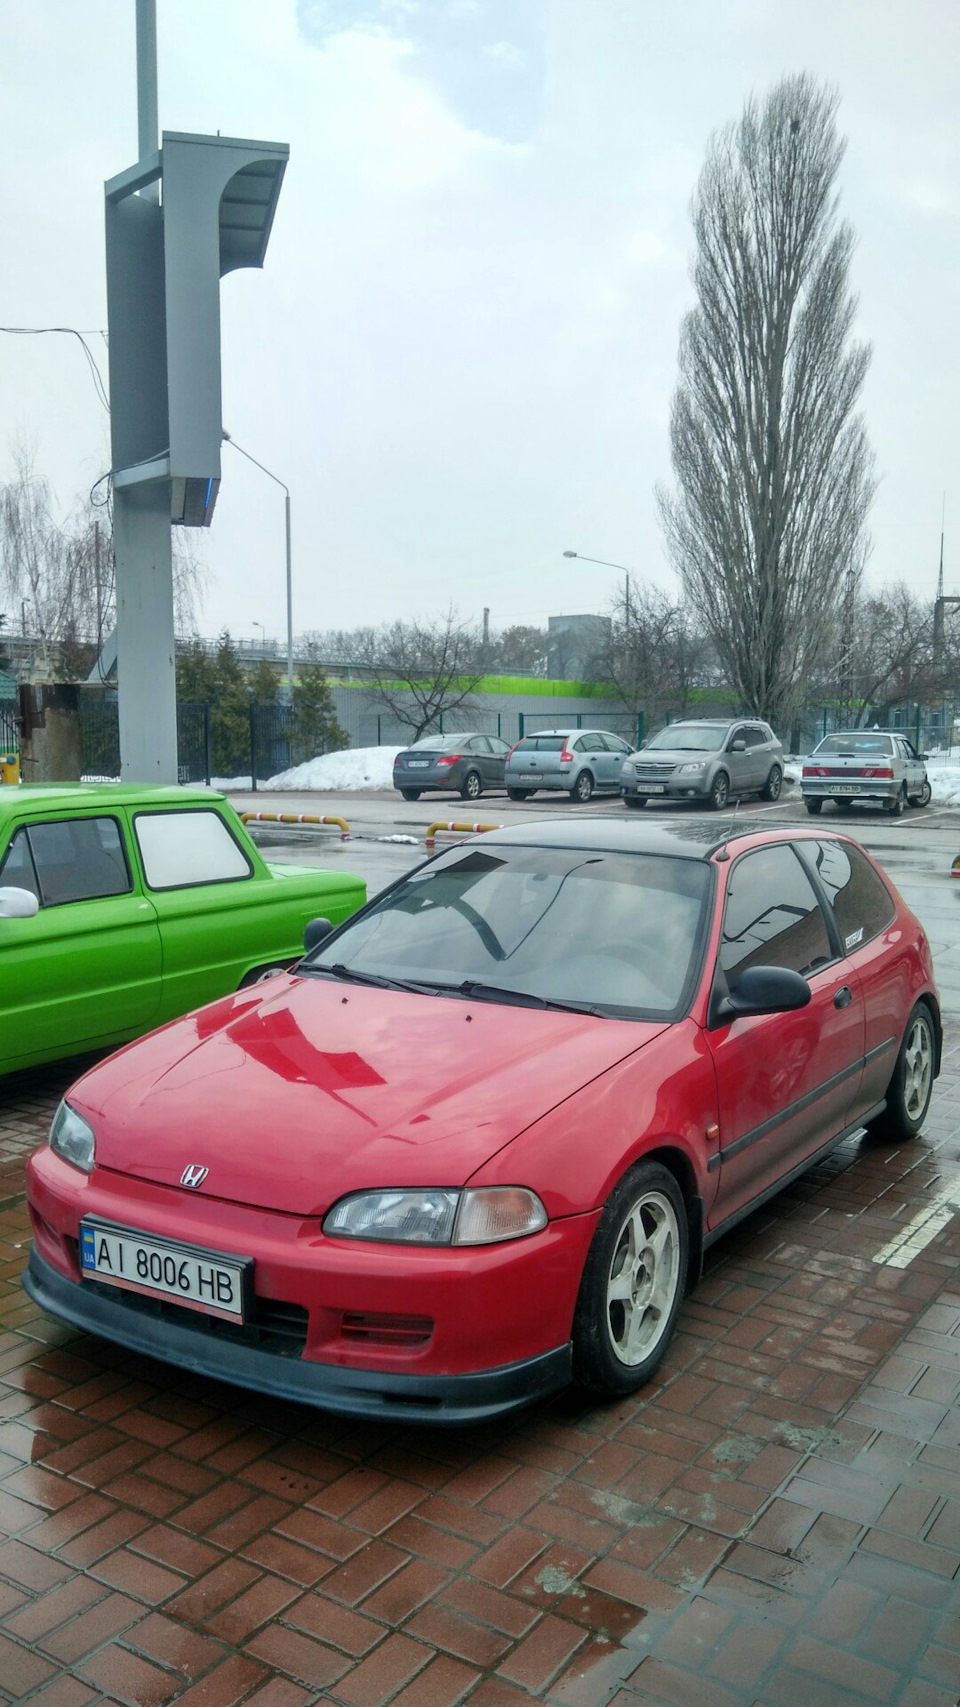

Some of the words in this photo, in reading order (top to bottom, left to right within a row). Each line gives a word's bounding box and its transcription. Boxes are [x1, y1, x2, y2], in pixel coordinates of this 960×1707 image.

[84, 1252, 95, 1264] UA
[97, 1238, 124, 1272] AI
[136, 1249, 190, 1291] 8006
[198, 1265, 233, 1304] HB
